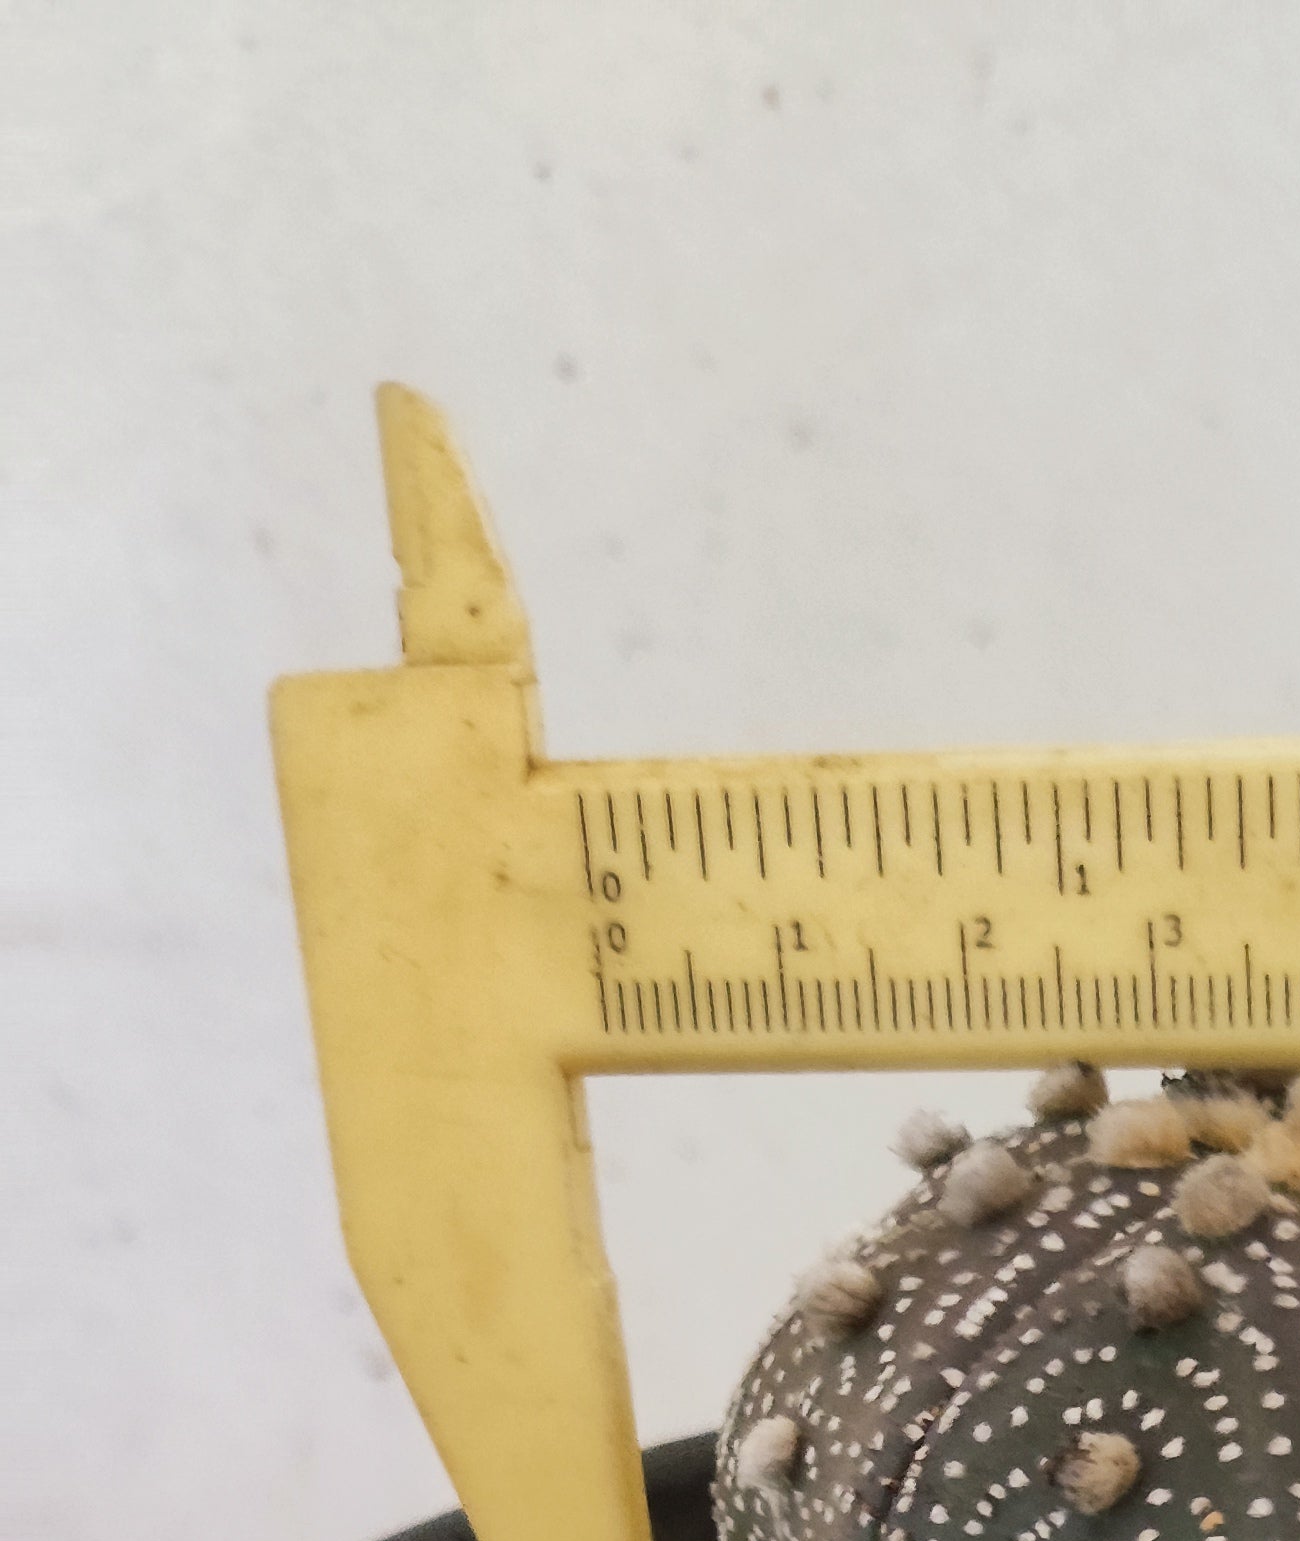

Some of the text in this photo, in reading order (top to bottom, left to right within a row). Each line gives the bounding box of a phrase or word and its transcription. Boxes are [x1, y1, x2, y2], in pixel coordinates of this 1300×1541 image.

[602, 871, 622, 902] 0
[1075, 864, 1091, 896] 1
[607, 922, 627, 954] 0
[791, 921, 808, 952] 1
[975, 916, 993, 949] 2
[1162, 914, 1184, 946] 3
